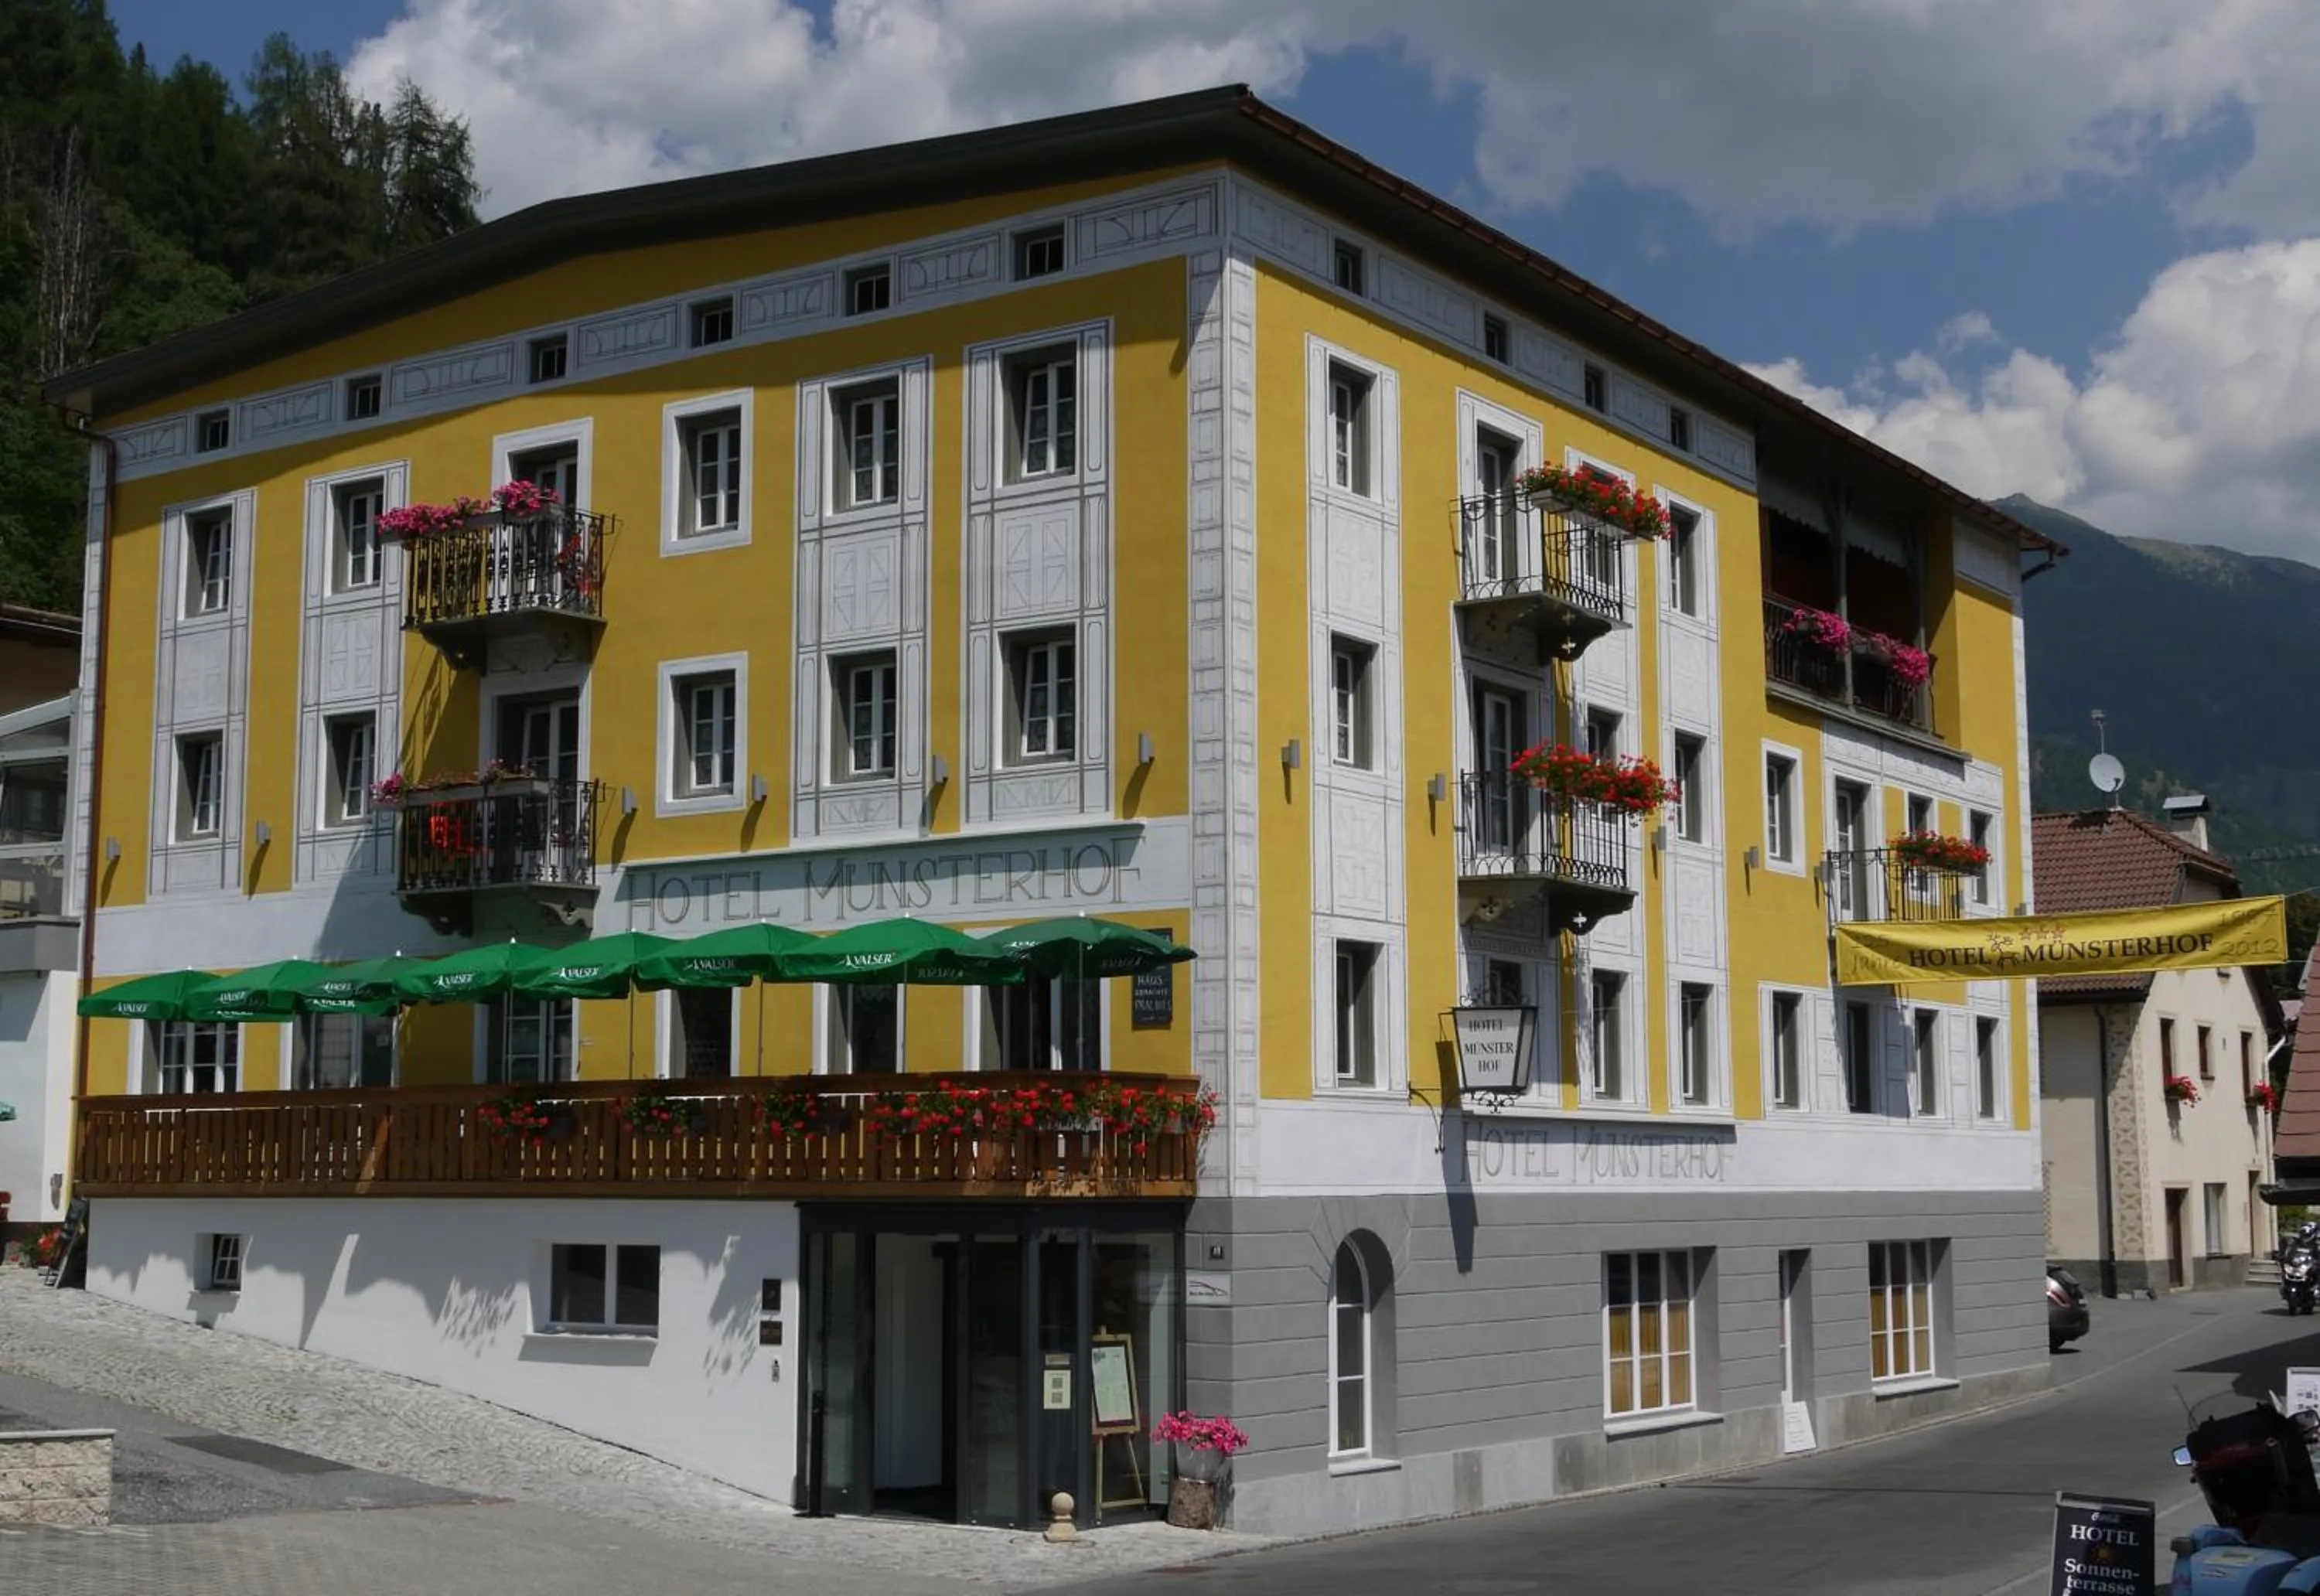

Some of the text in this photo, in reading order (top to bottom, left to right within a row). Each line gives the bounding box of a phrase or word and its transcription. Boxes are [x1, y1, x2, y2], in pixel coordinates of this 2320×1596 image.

[626, 869, 780, 930] HOTEL
[1909, 932, 2214, 968] HOTEL MÜNSTERHOF
[2219, 937, 2280, 957] 2012
[846, 953, 894, 966] VALSER
[1468, 1018, 1504, 1032] HOTEL
[1478, 1059, 1501, 1073] HOF
[1460, 1121, 1559, 1183] HOTEL
[2070, 1524, 2139, 1546] HOTEL
[2064, 1558, 2140, 1579] Sonnen-
[2066, 1574, 2135, 1596] terrasse
